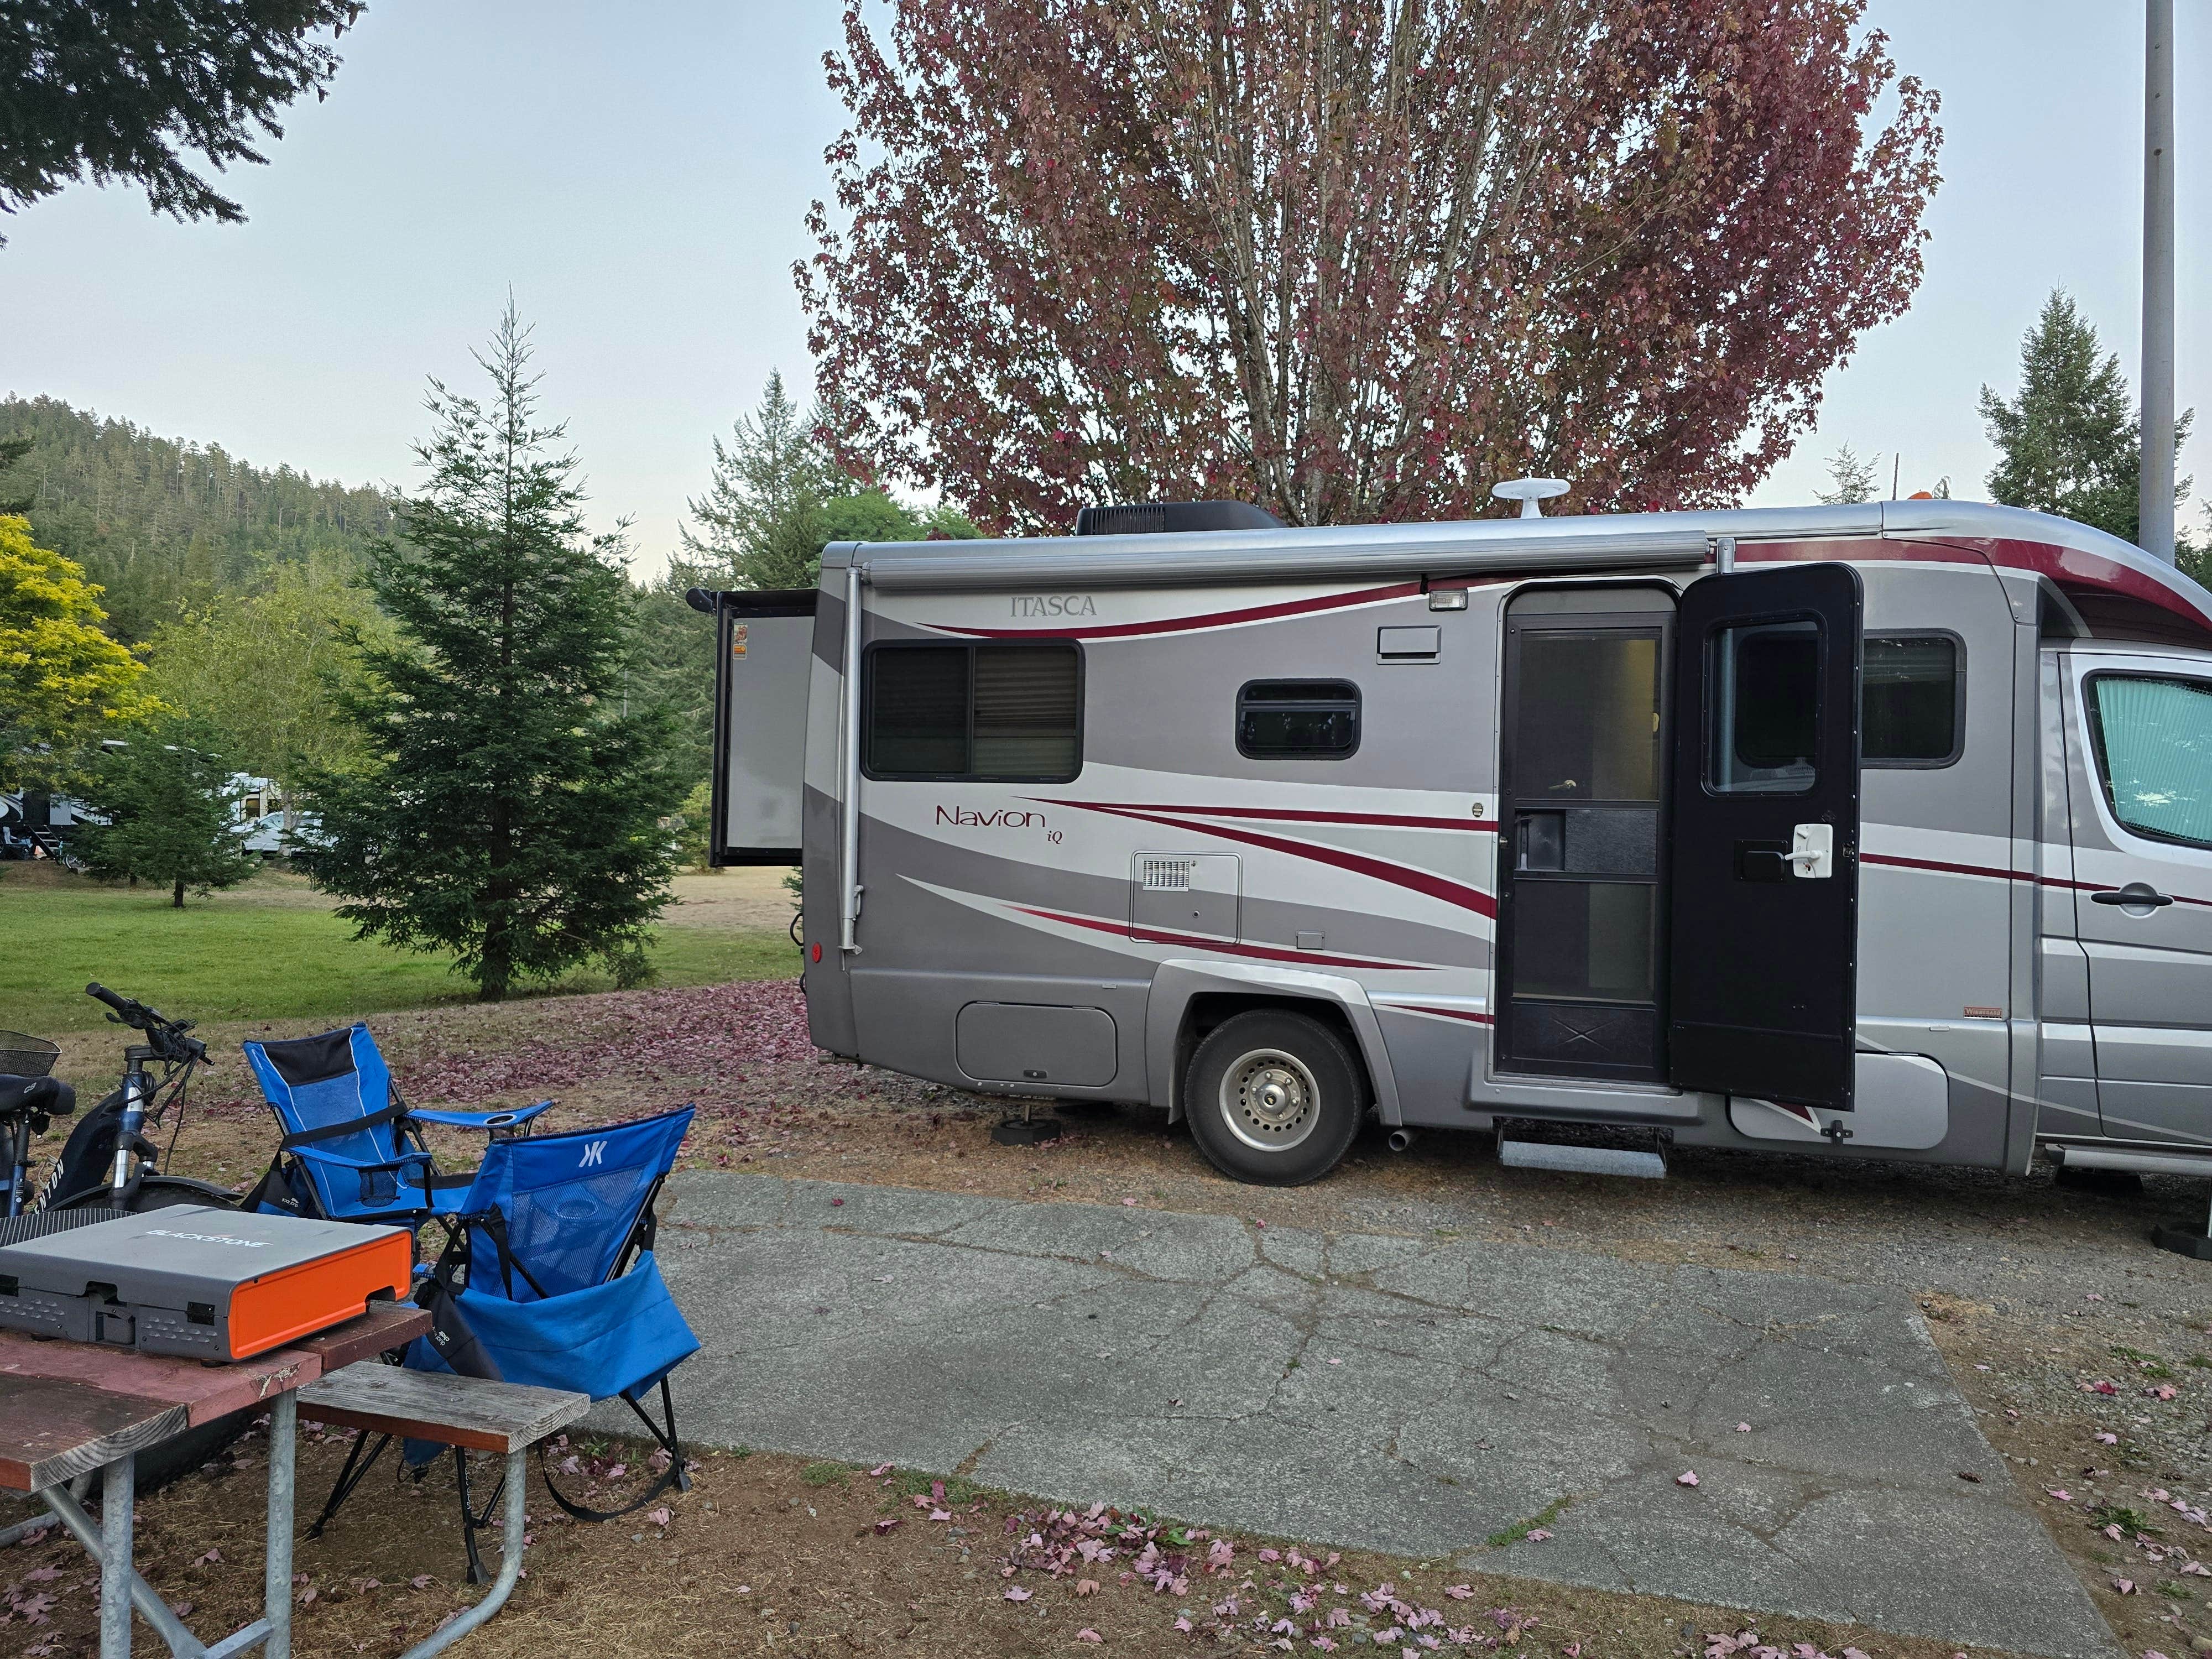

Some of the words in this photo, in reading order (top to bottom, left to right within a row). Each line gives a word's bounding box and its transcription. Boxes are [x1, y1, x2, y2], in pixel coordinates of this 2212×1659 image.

[1010, 595, 1097, 617] ITASCA
[936, 805, 1045, 827] Navion
[1047, 831, 1063, 844] iQ
[145, 1229, 265, 1248] BLACKSTONE
